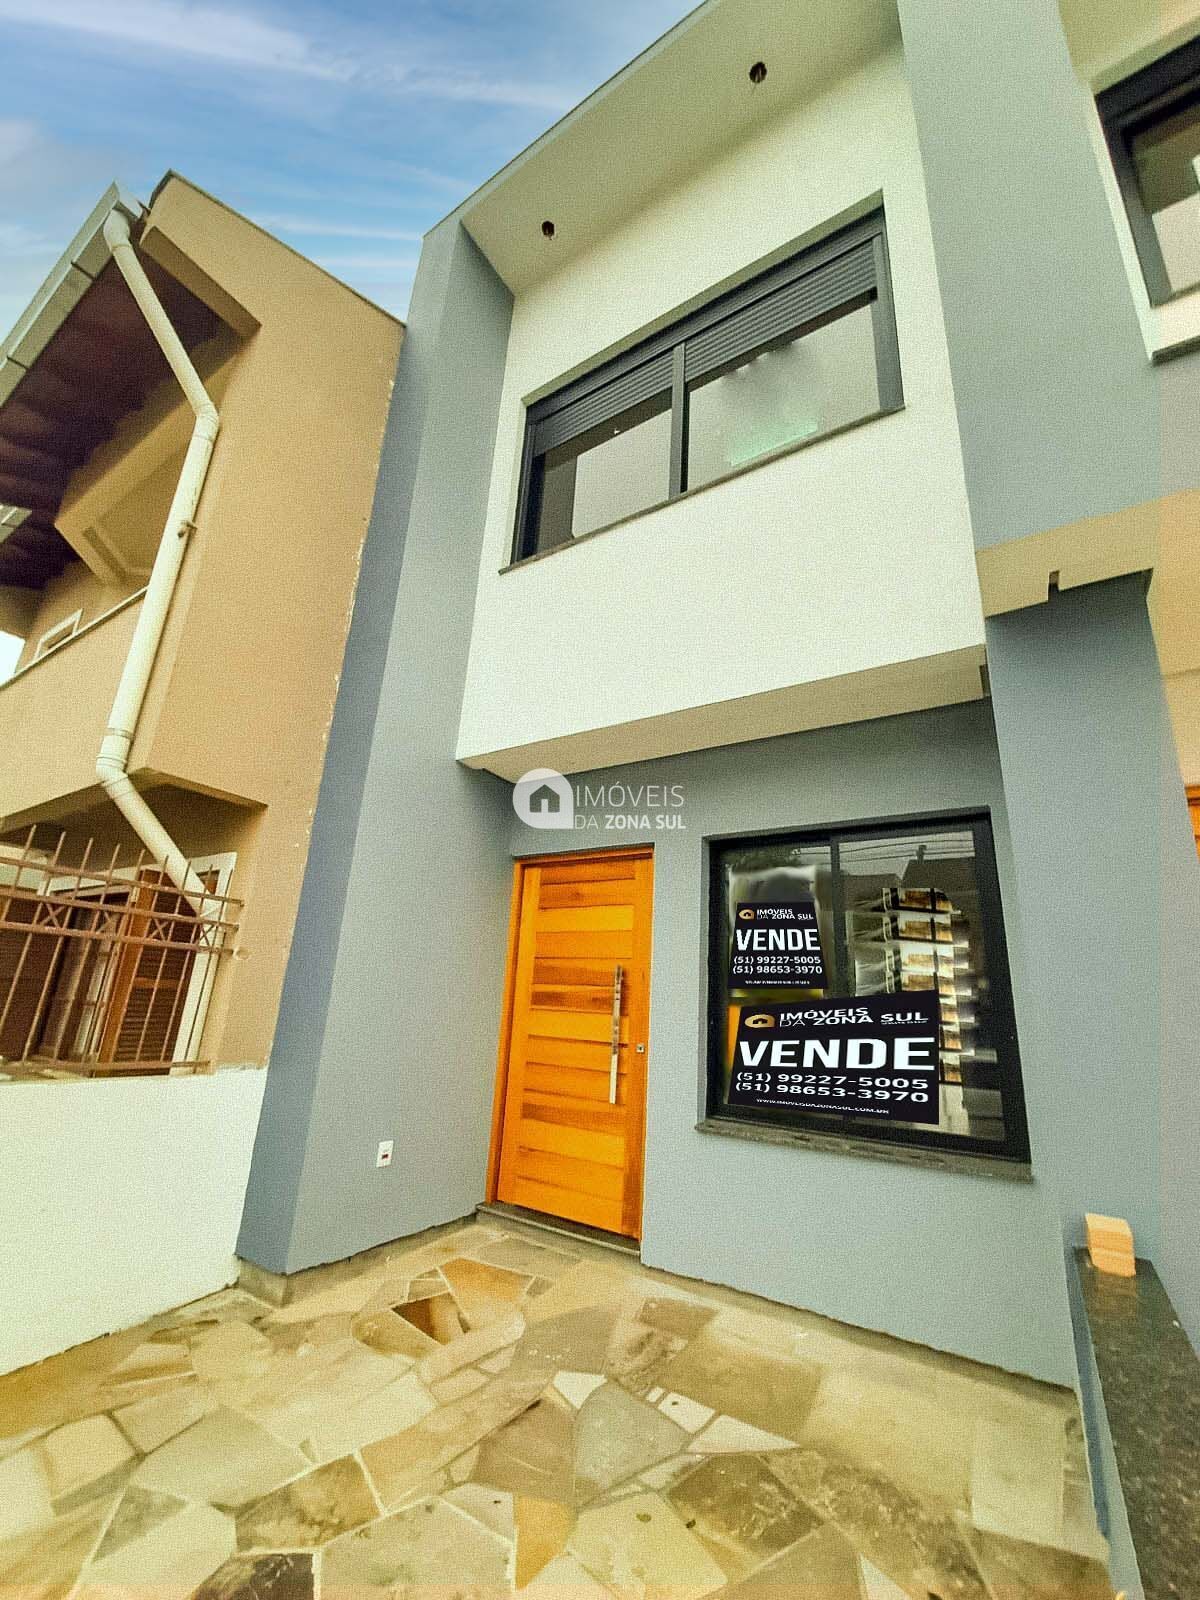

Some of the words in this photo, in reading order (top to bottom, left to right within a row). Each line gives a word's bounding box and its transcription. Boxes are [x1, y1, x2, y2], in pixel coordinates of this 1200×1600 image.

[736, 928, 821, 951] VENDE
[734, 955, 754, 964] (51)
[757, 956, 821, 964] 99227-5005
[733, 965, 754, 974] (51)
[756, 965, 823, 974] 98653-3970
[779, 1018, 806, 1028] DA
[812, 1015, 874, 1026] ZONA
[880, 1012, 929, 1023] SUL
[780, 1007, 869, 1021] IMÓVEIS
[739, 1037, 936, 1071] VENDE
[736, 1071, 772, 1083] (51)
[777, 1073, 929, 1090] 99227-5005
[735, 1082, 770, 1094] (51)
[776, 1083, 929, 1104] 98653-3970
